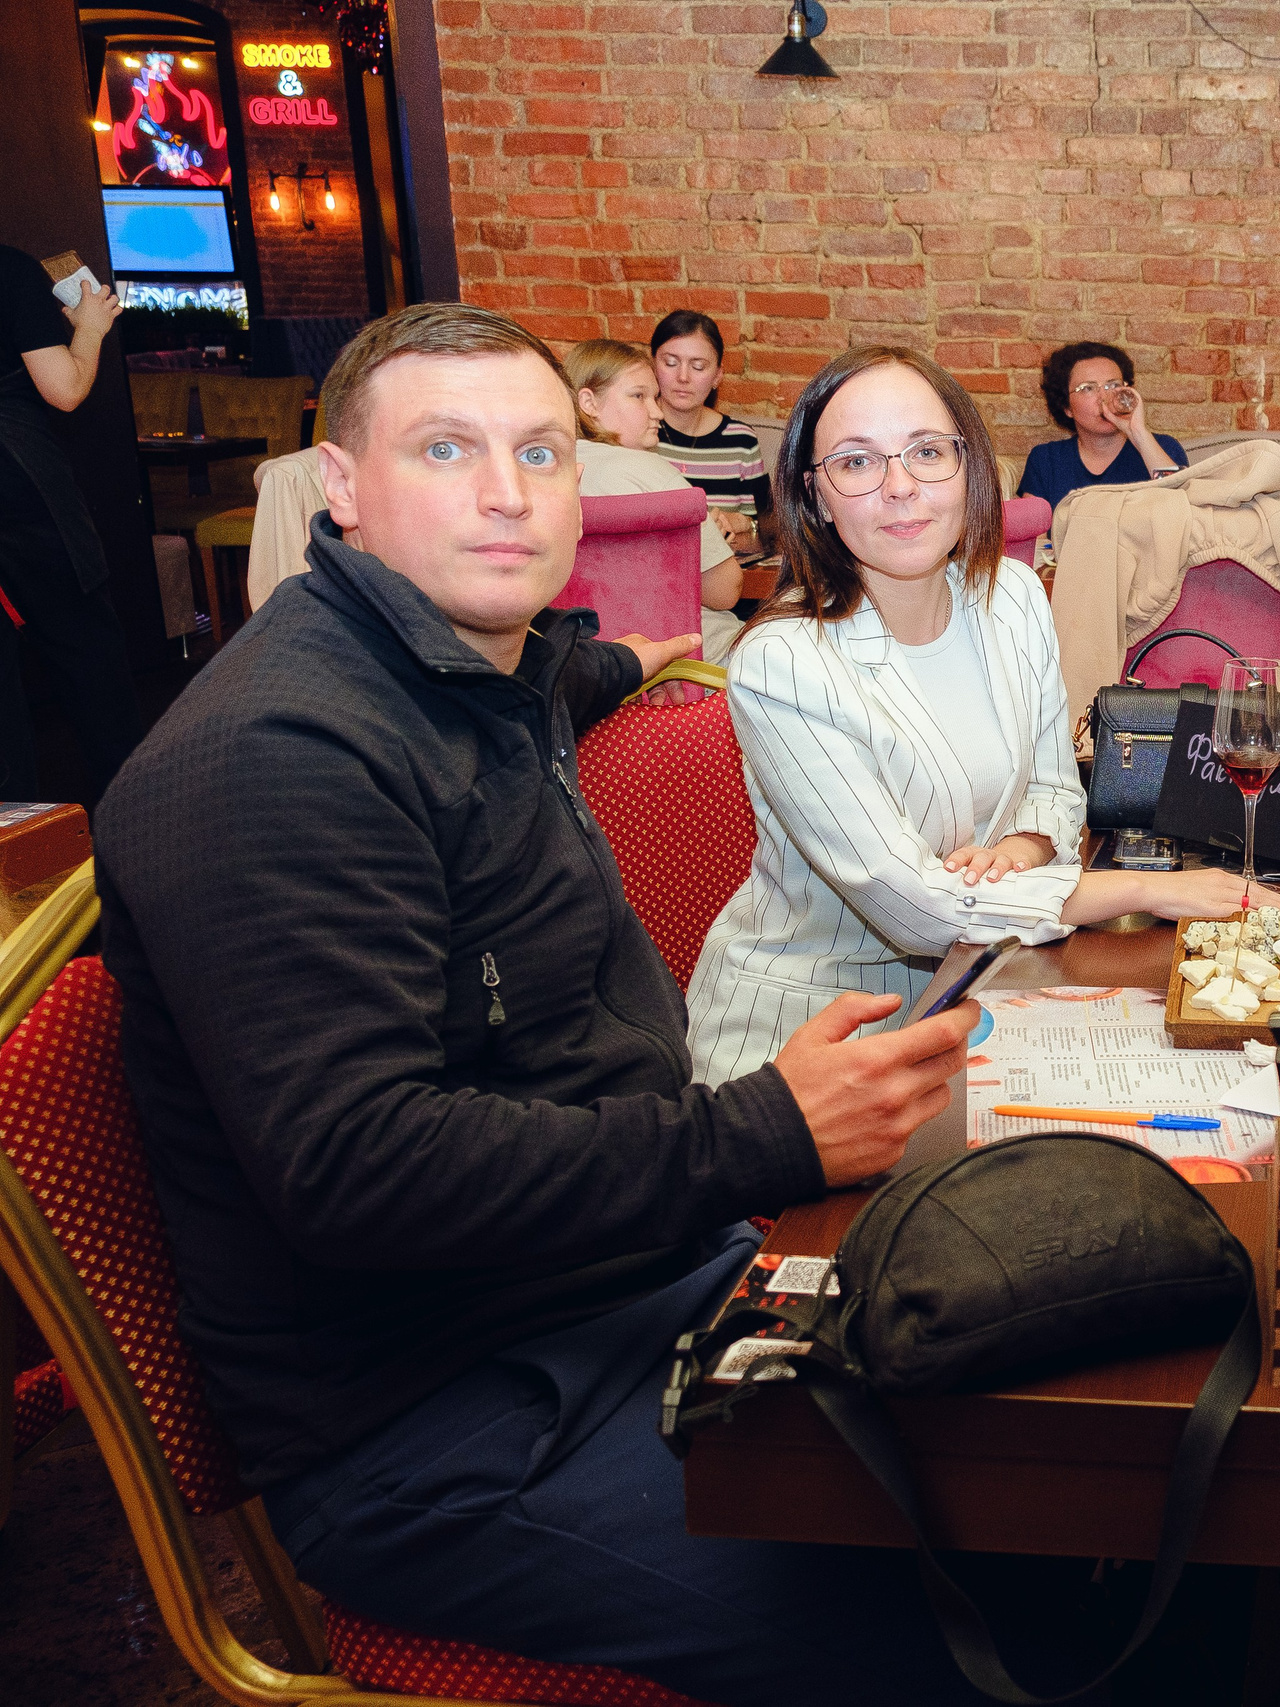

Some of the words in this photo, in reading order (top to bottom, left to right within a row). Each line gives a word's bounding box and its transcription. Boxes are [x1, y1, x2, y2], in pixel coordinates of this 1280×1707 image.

[242, 43, 332, 68] SMOKE
[277, 70, 304, 97] &
[248, 98, 338, 125] GRILL
